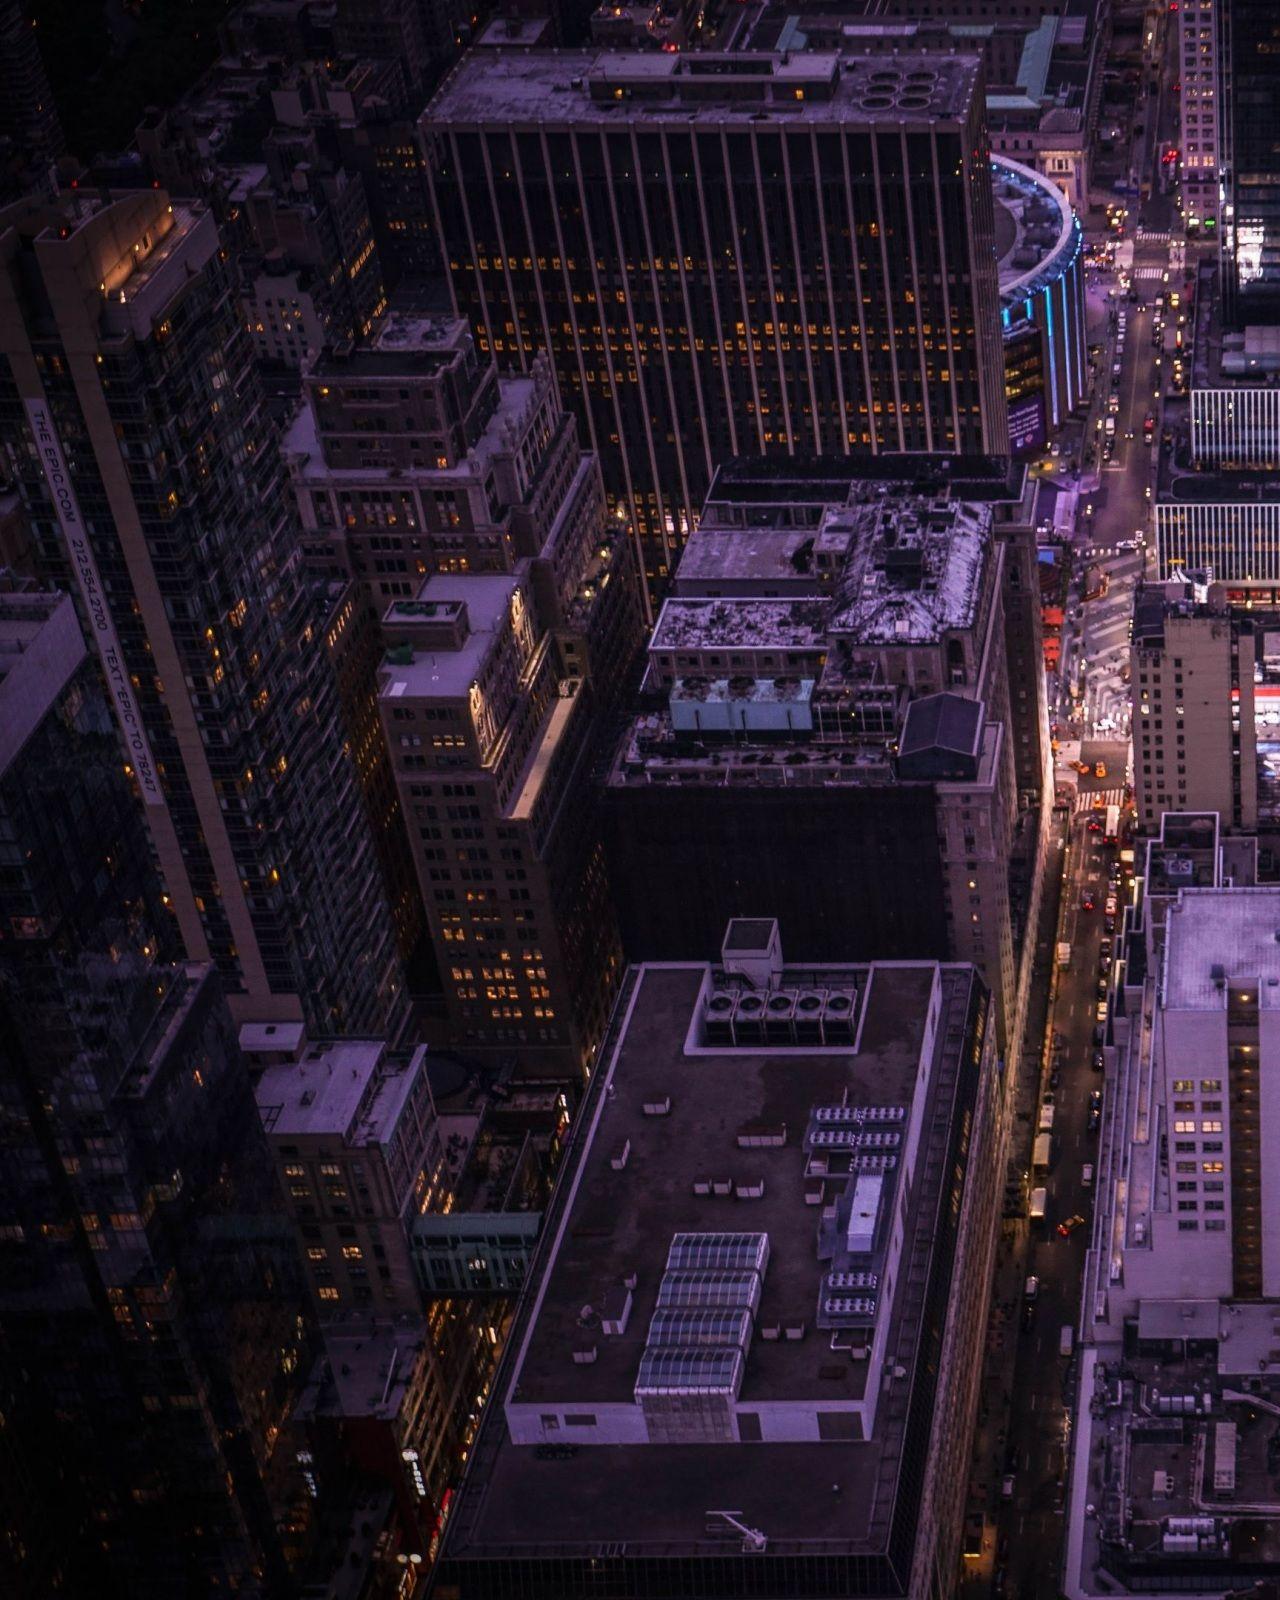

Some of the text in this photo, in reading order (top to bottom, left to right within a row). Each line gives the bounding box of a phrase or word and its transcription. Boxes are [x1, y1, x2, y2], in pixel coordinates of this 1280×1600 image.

[34, 410, 52, 442] THE
[104, 646, 124, 685] TEXT
[130, 730, 144, 751] TO
